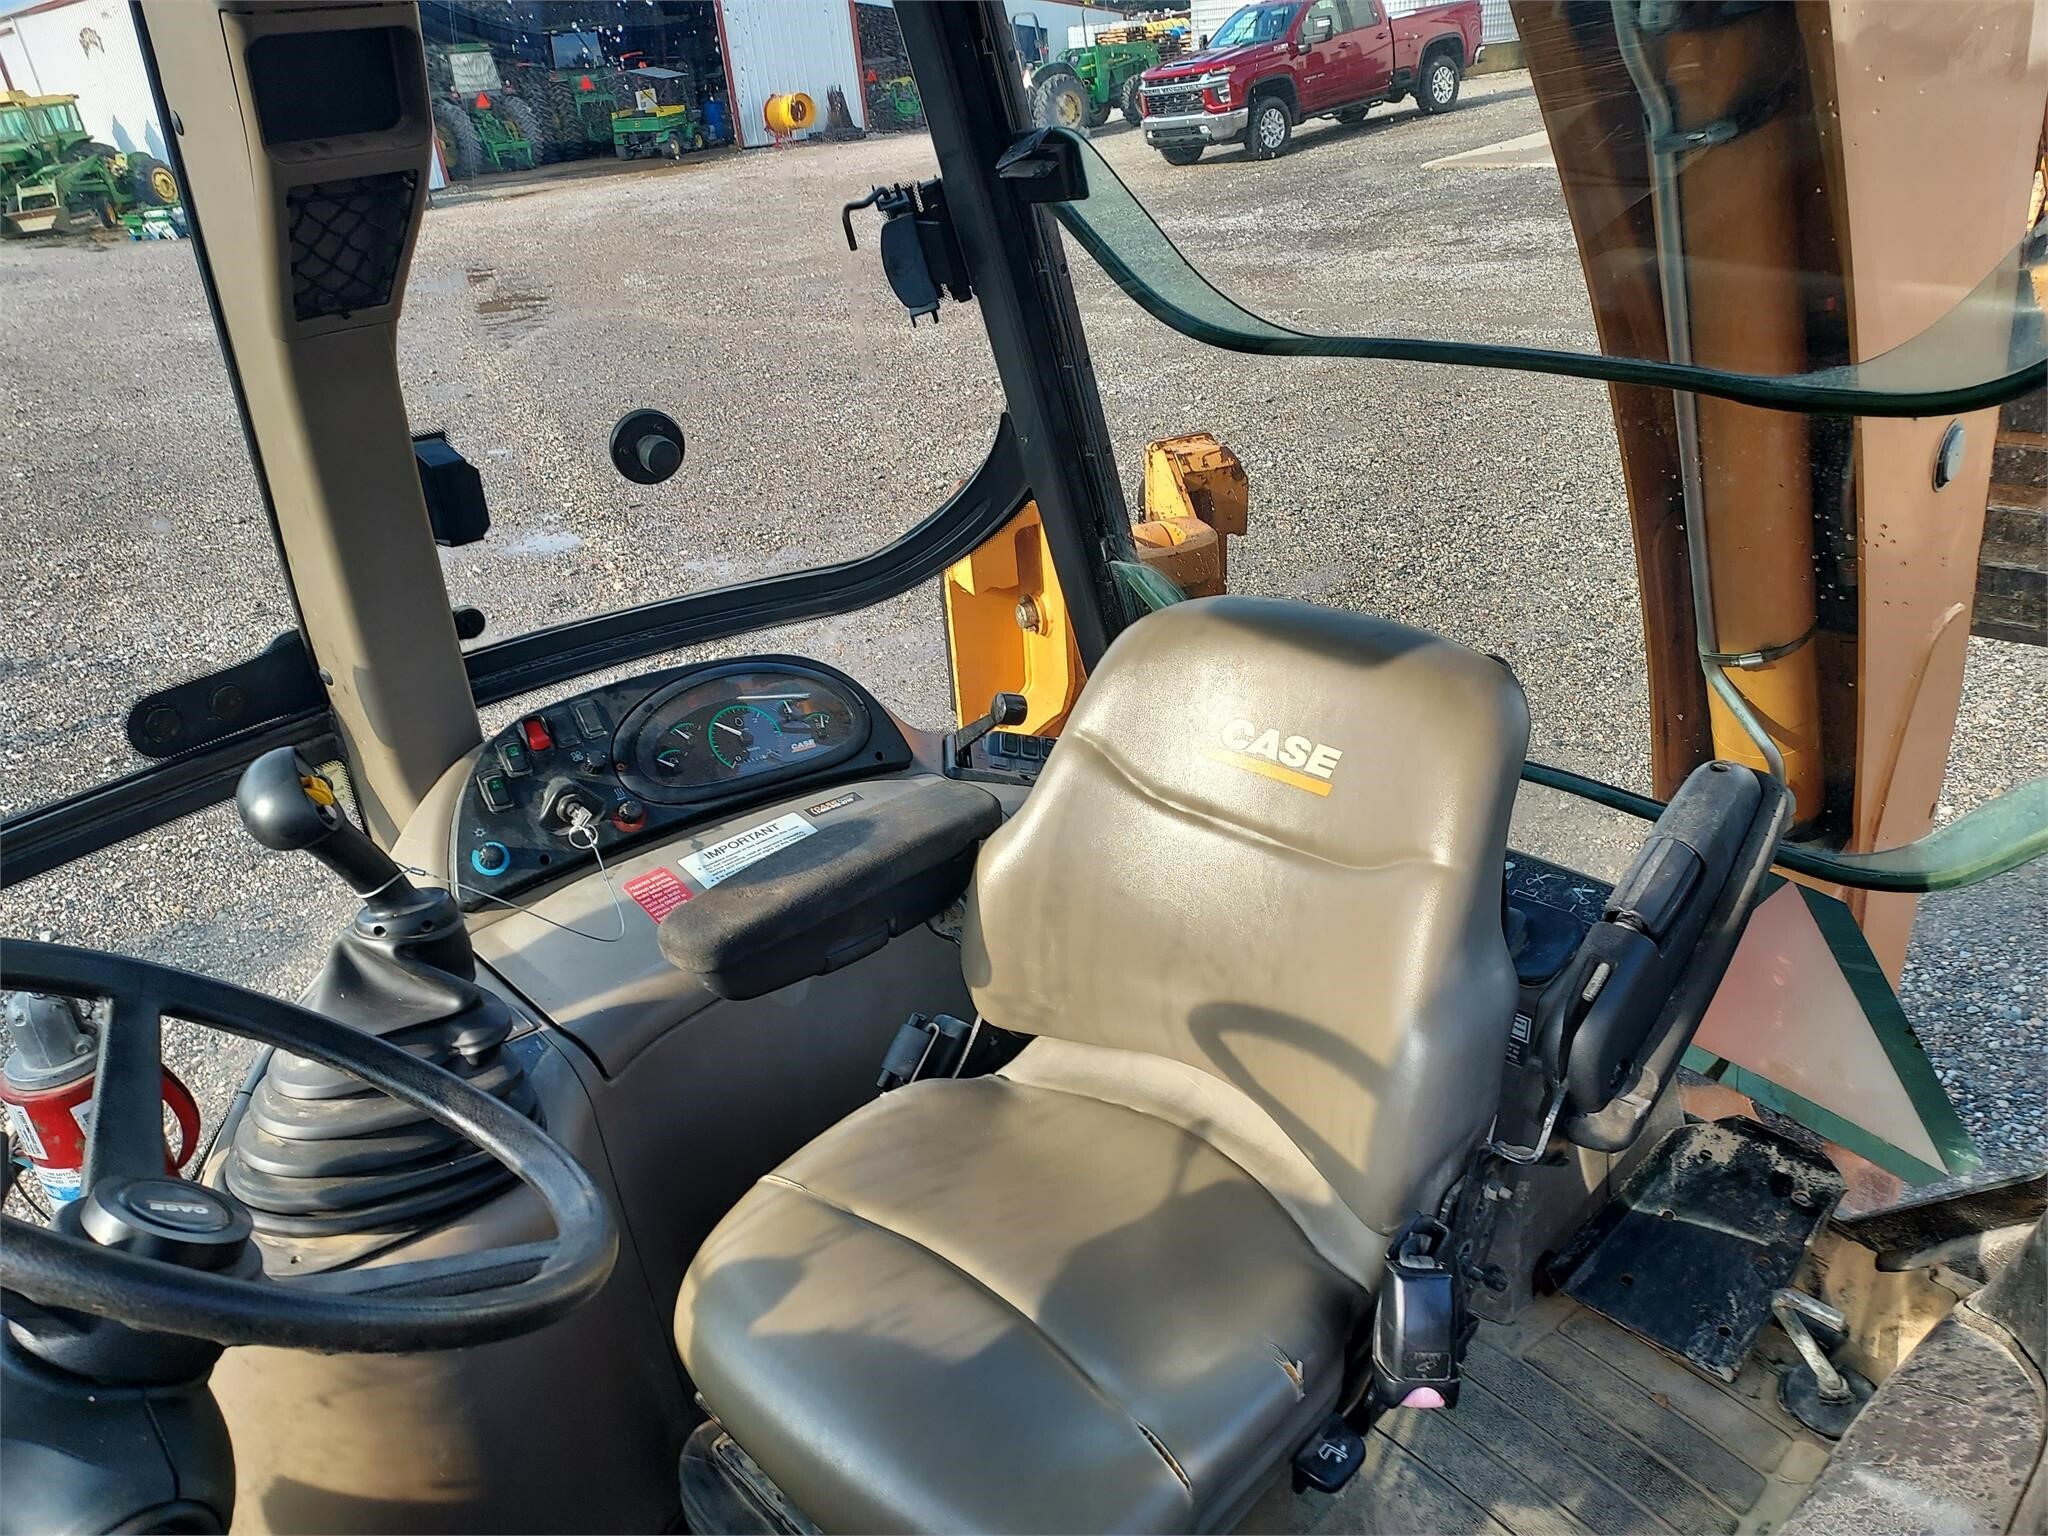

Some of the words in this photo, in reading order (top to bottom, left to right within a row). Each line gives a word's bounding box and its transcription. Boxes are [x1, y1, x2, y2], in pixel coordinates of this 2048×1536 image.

[791, 738, 815, 750] CASE
[1221, 719, 1343, 779] CASE
[703, 823, 780, 860] IMPORTANT
[150, 1203, 209, 1214] CASE
